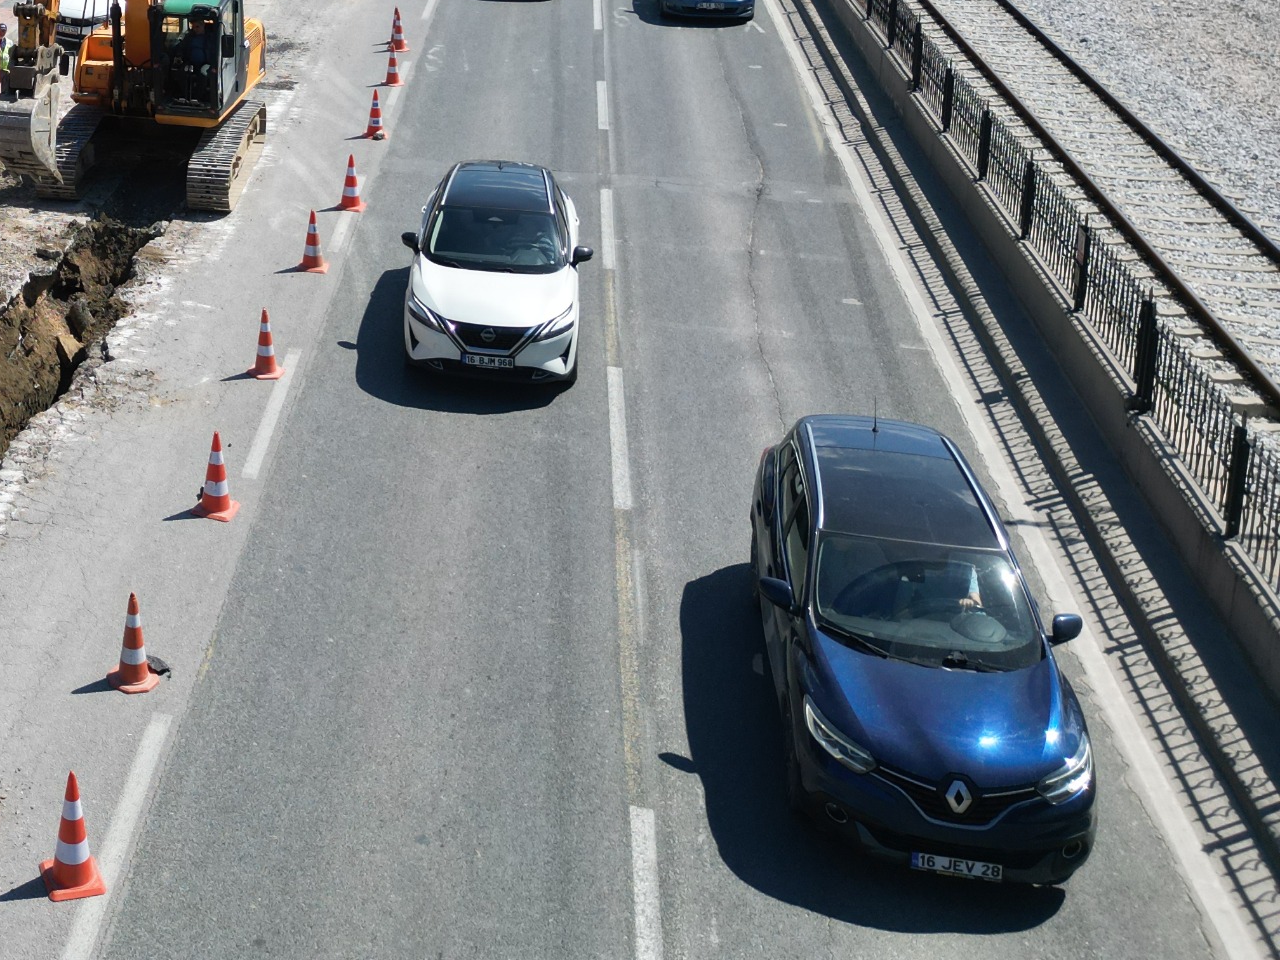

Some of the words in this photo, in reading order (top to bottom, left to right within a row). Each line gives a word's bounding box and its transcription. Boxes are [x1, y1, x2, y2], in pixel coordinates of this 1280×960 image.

[466, 355, 476, 364] 16
[478, 356, 496, 366] BJM
[497, 358, 513, 367] 968
[920, 854, 936, 868] 16
[941, 858, 976, 874] JEV
[980, 864, 1001, 877] 28
